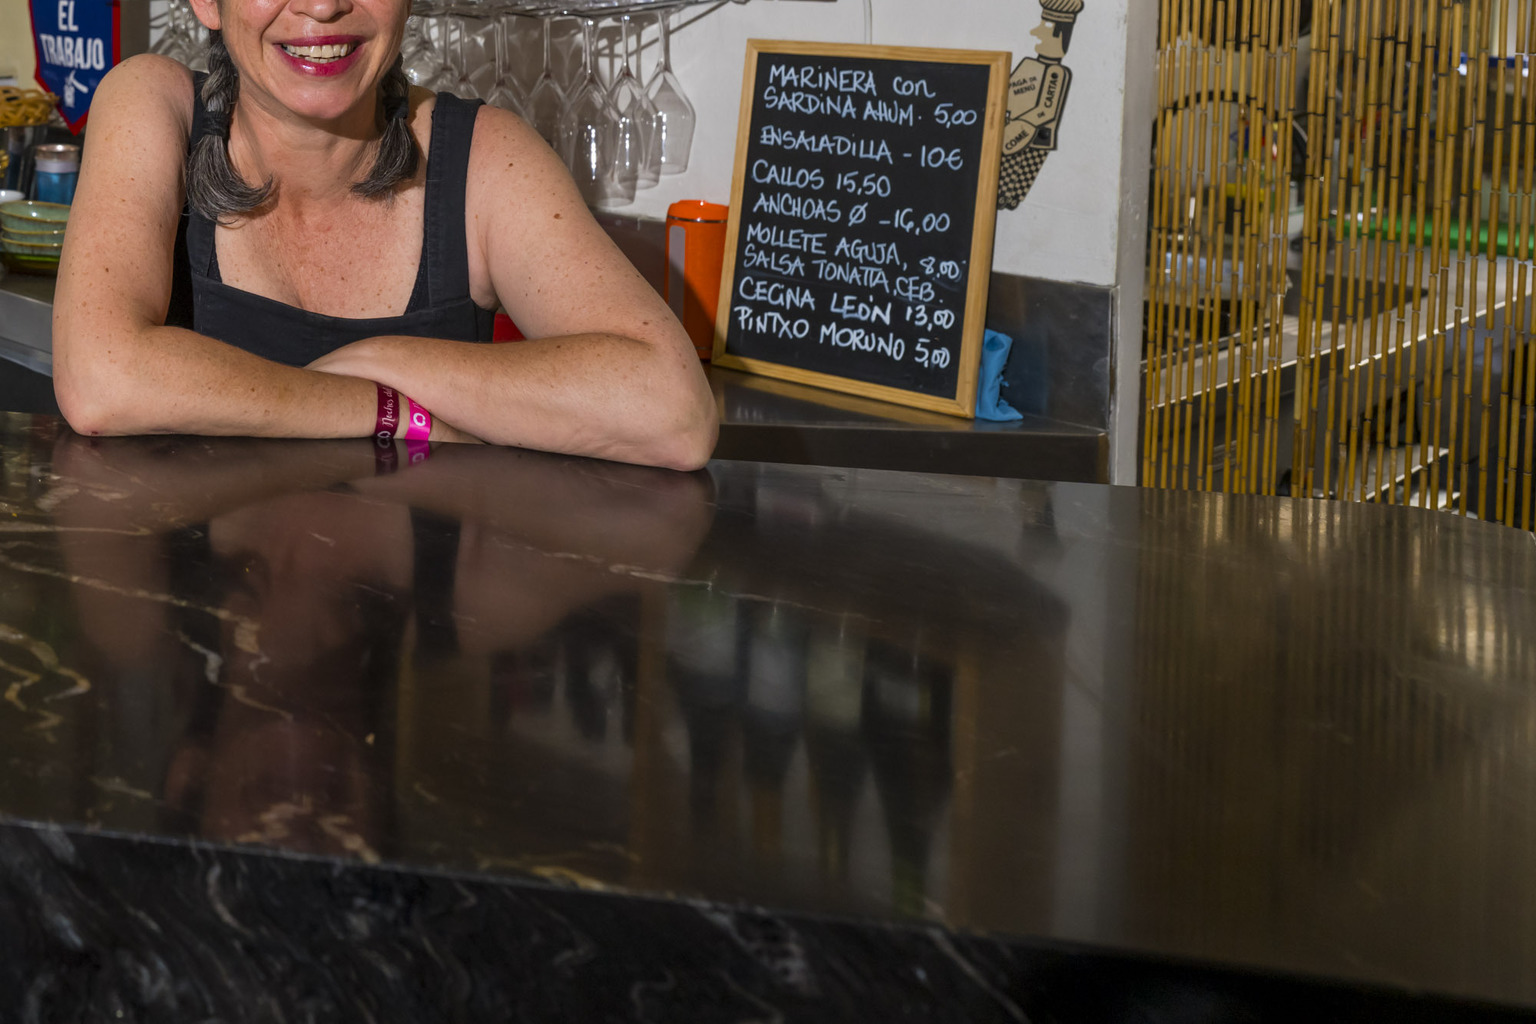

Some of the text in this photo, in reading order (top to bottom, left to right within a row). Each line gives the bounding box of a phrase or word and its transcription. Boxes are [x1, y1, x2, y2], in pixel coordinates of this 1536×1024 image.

[58, 0, 79, 32] EL
[39, 34, 105, 71] TRABAJO
[933, 103, 977, 129] 5,00
[1005, 129, 1029, 150] COME
[1044, 78, 1059, 108] CARTA
[920, 145, 963, 171] 10€
[752, 159, 891, 198] CALLOS 15,50
[752, 192, 842, 224] ANCHOAS
[745, 222, 828, 254] MOLLETE
[743, 243, 805, 276] SALSA
[905, 304, 955, 332] 13,00
[819, 321, 906, 361] MORUNO
[914, 338, 951, 369] 5,00
